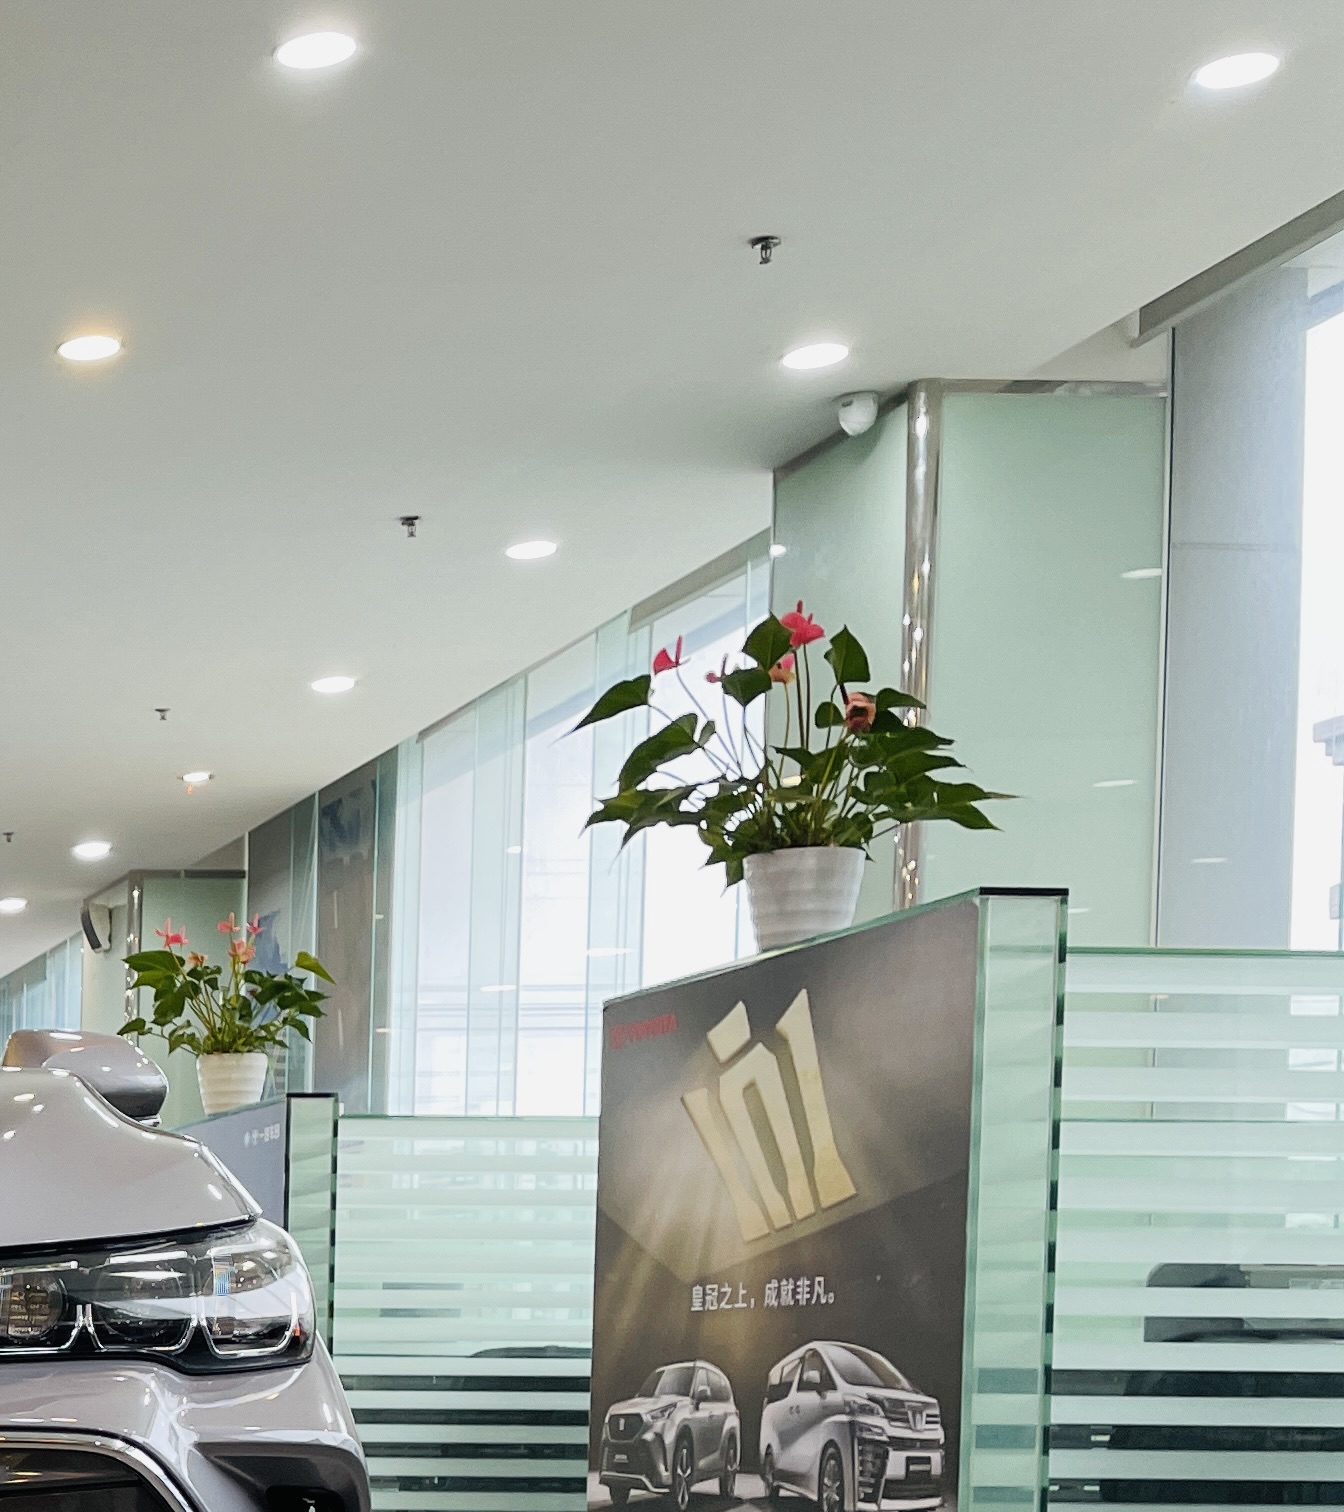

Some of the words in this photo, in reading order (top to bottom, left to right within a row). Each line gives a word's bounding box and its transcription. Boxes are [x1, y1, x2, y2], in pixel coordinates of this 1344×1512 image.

[691, 1276, 835, 1311] 皇冠之上，成就非凡。
